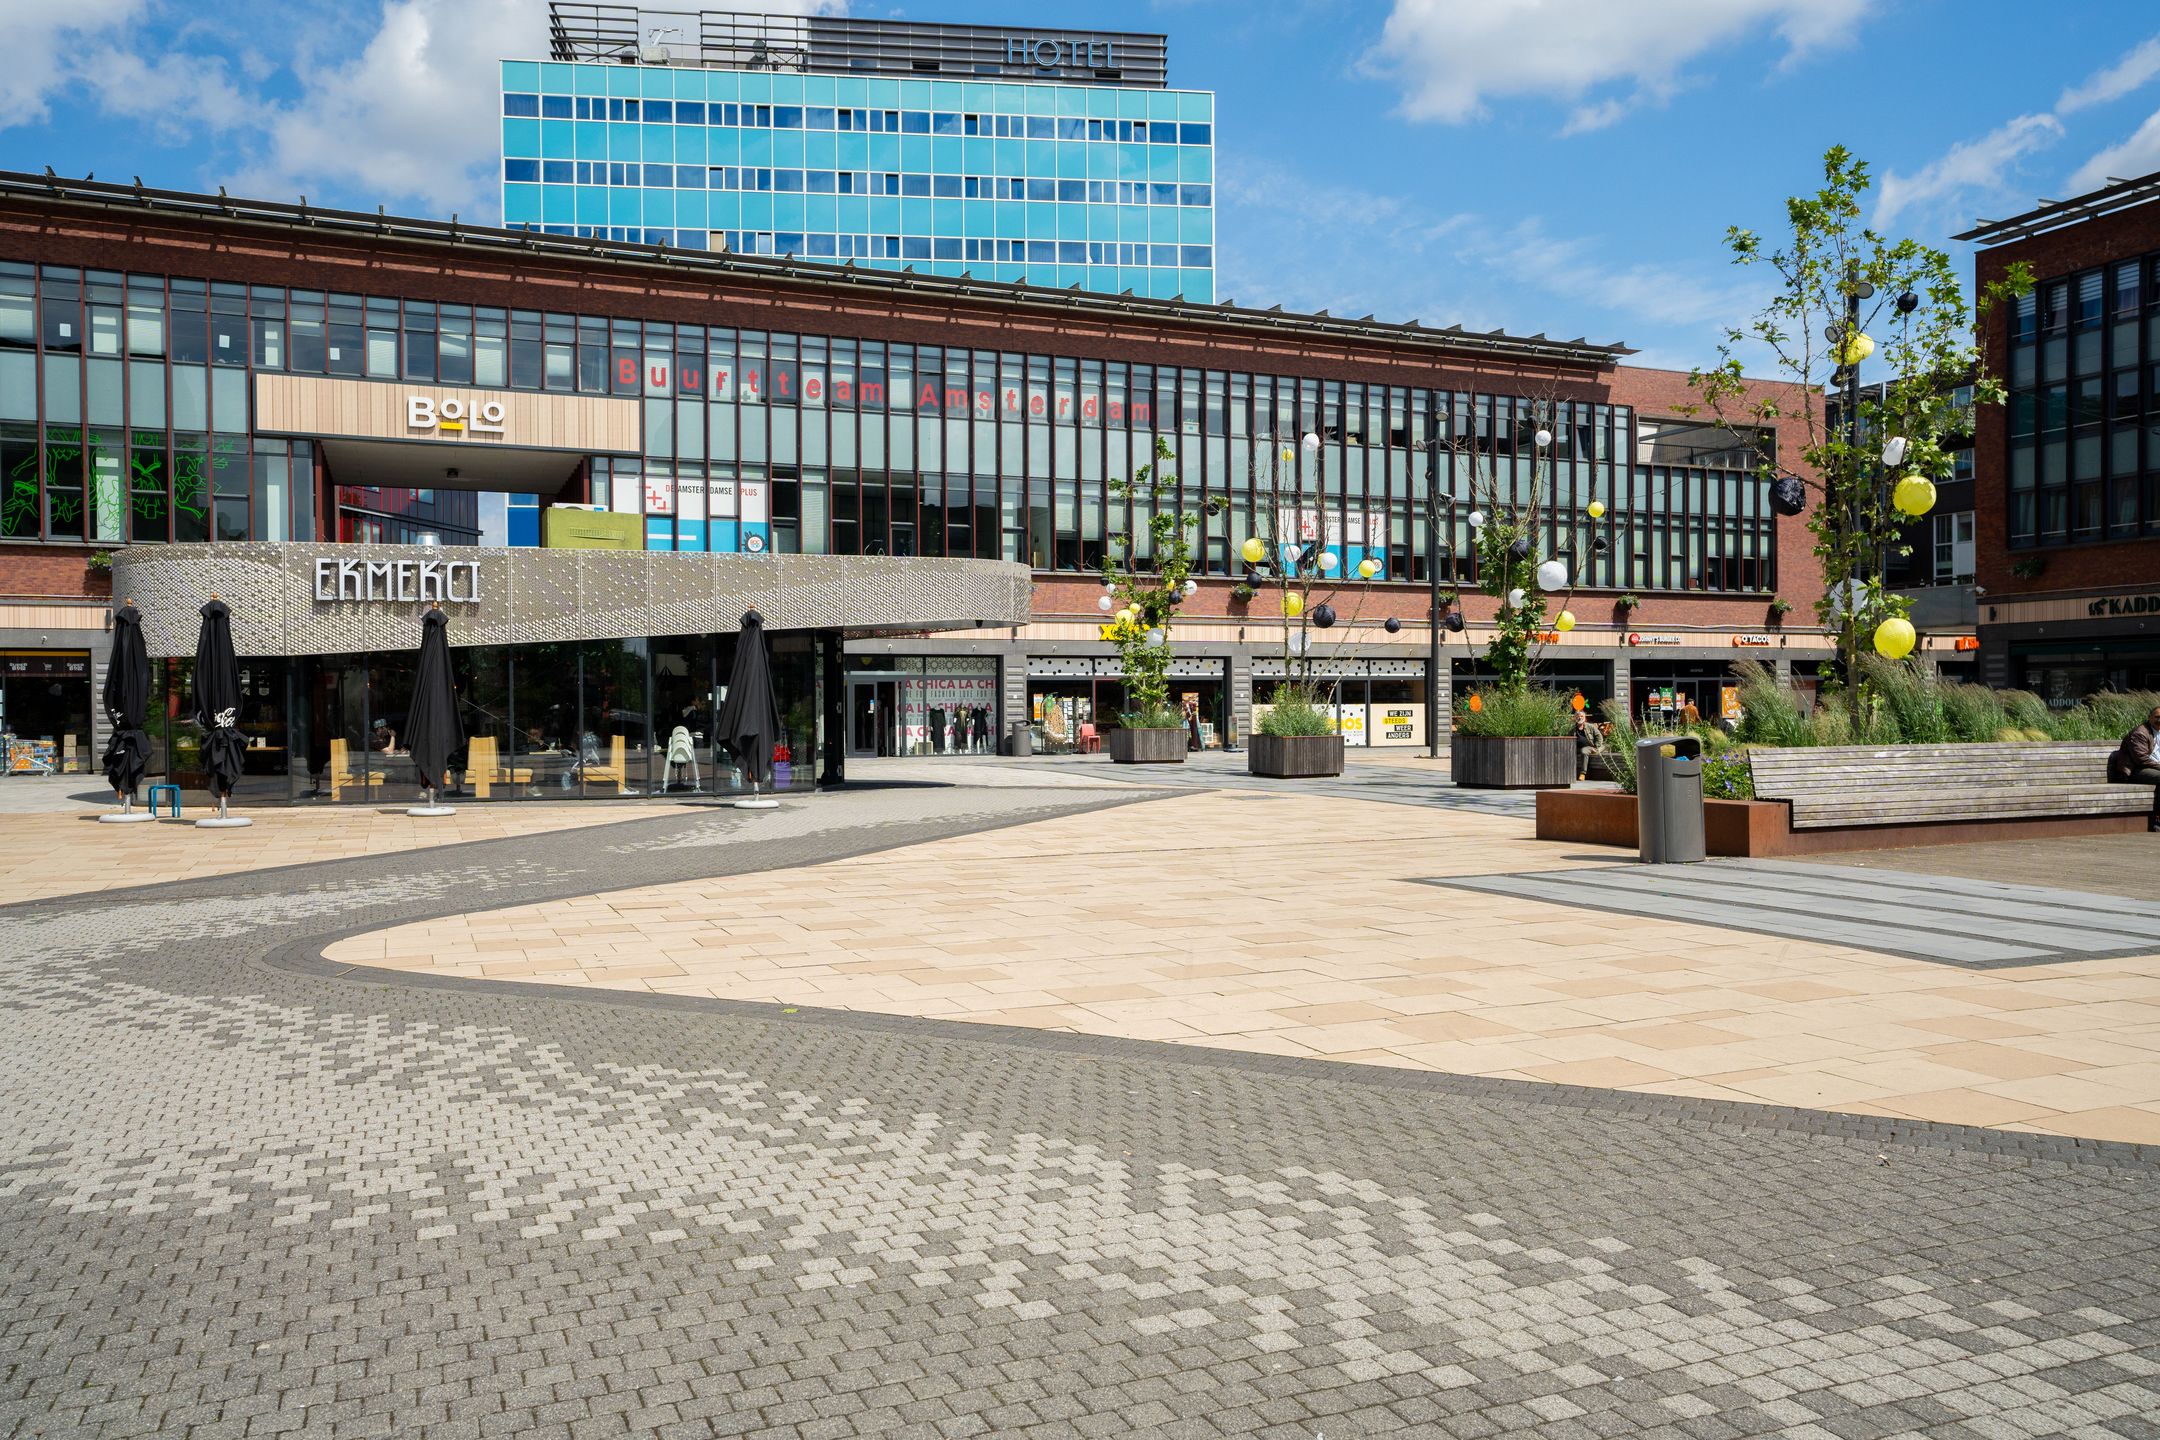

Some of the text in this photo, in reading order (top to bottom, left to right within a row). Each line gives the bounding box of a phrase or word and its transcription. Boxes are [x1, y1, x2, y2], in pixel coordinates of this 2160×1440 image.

[1007, 37, 1119, 68] HOTEL
[618, 357, 1150, 422] Buurtteam Amsterdam
[741, 487, 758, 497] PLUS
[315, 557, 481, 603] EKMEKCI
[917, 679, 955, 689] CHICA
[958, 679, 973, 689] LA
[2045, 697, 2082, 707] ADDOUR
